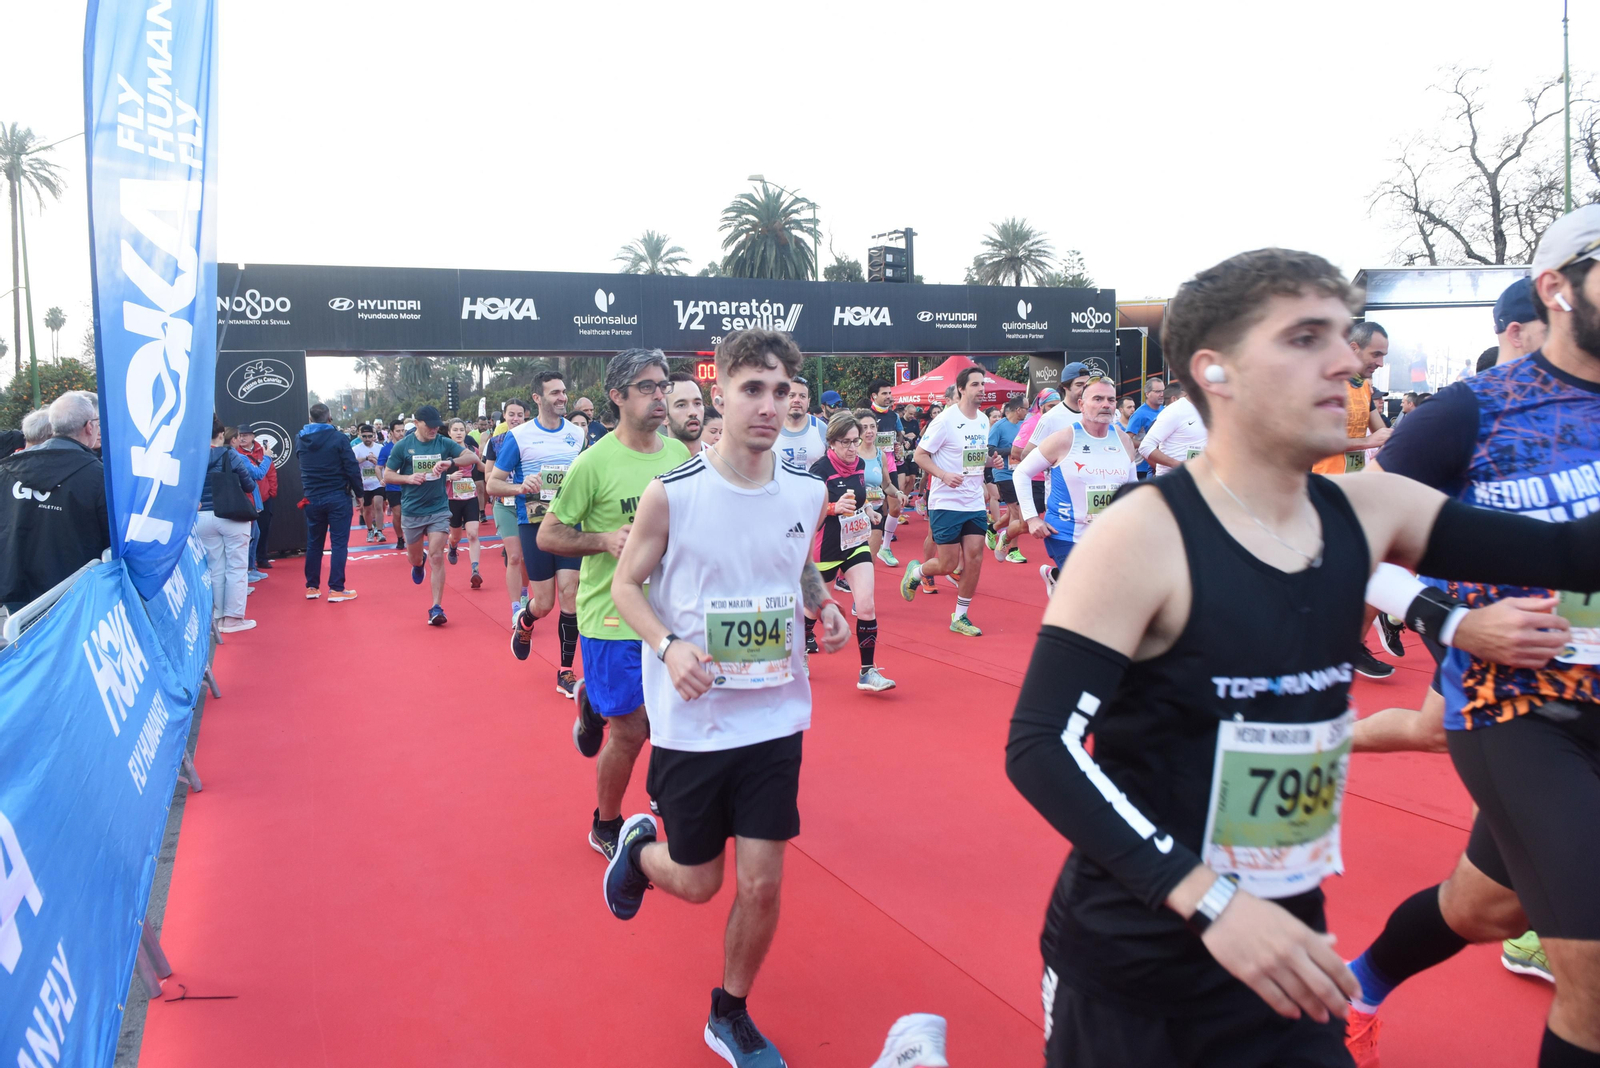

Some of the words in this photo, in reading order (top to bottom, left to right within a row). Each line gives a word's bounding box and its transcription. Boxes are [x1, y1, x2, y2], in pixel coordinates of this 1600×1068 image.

[146, 0, 175, 163] HUMAN
[117, 73, 145, 154] FLY
[175, 96, 203, 170] FLY
[357, 299, 421, 310] HYUNDAI
[461, 297, 539, 320] HOKA
[700, 299, 785, 316] maratón
[357, 312, 397, 320] Hyundauto
[399, 312, 421, 320] Motor
[573, 314, 638, 327] quirónsalud
[833, 306, 893, 326] HOKA
[935, 312, 978, 322] HYUNDAI
[1002, 320, 1048, 331] quirónsalud
[711, 336, 722, 345] 28
[120, 178, 203, 546] HOKA
[967, 452, 985, 462] 6687
[1471, 477, 1550, 510] MEDIO
[766, 595, 787, 609] SEVILLA
[721, 618, 781, 648] 7994
[83, 599, 150, 738] HOKA
[127, 744, 149, 796] FLY
[39, 941, 78, 1045] FLY
